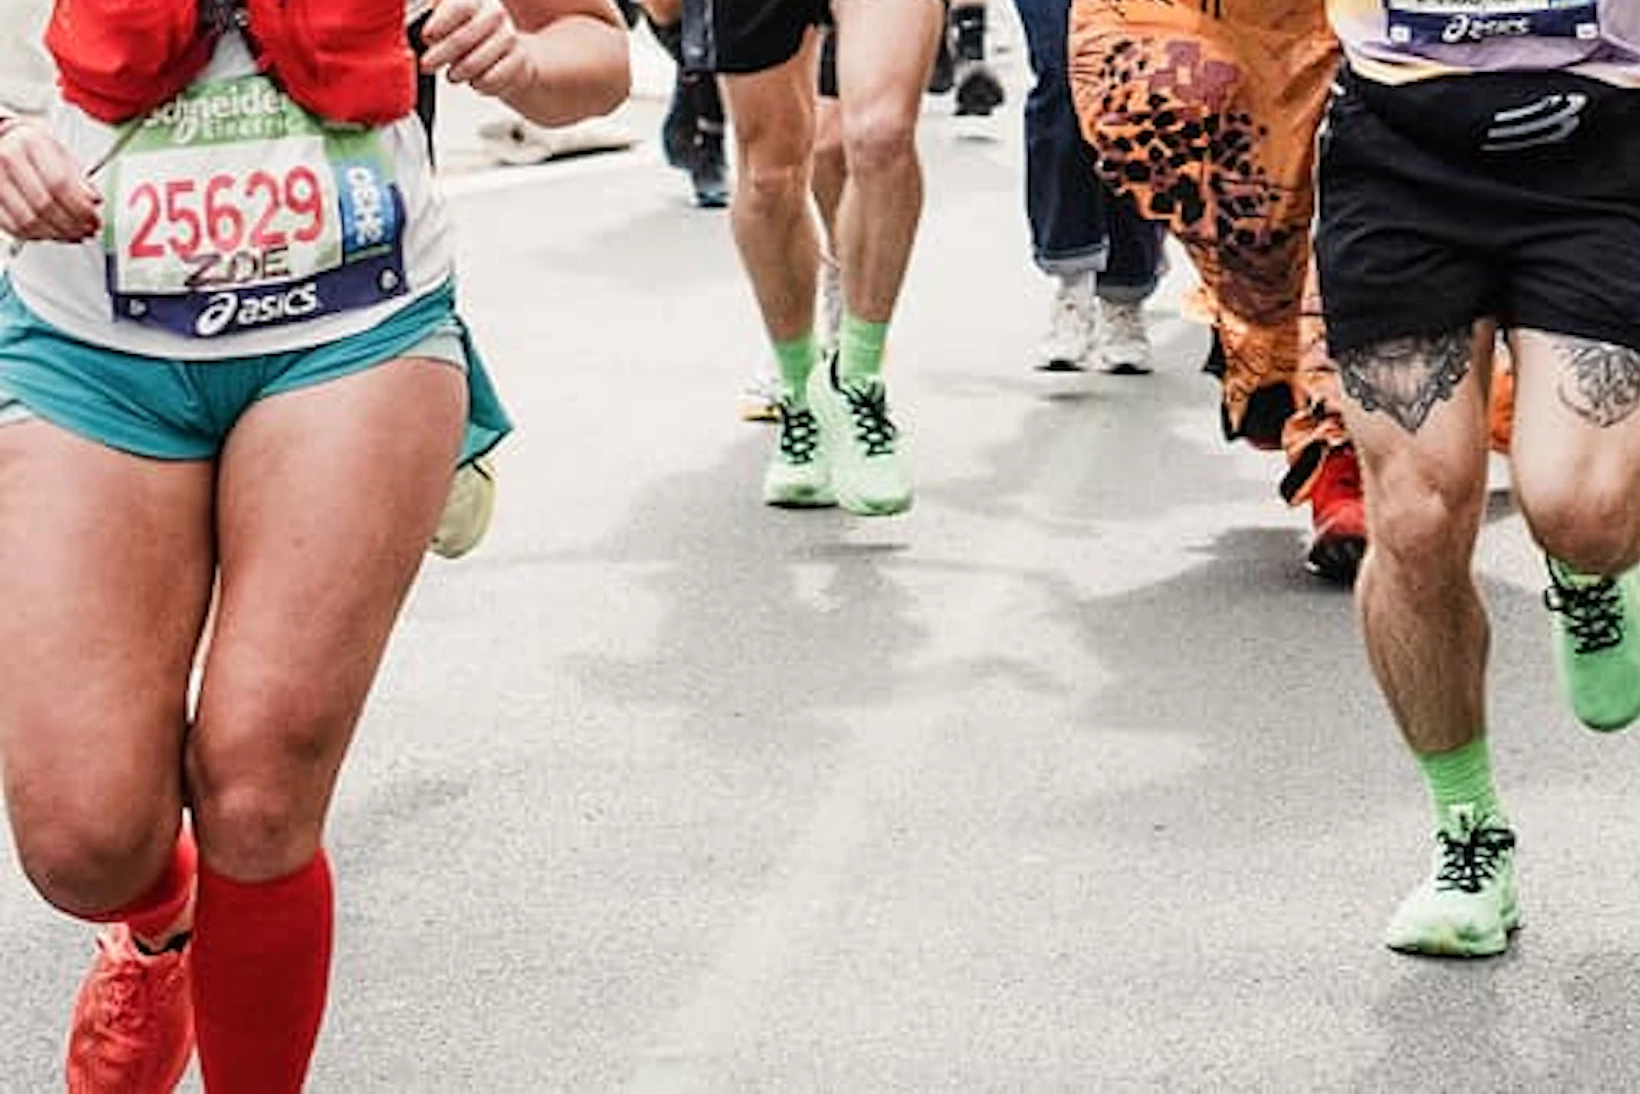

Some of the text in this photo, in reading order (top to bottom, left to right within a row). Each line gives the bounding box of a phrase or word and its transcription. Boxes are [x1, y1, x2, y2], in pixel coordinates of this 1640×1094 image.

[127, 165, 323, 261] 25629
[184, 245, 290, 287] ZOE
[237, 282, 318, 326] asics
